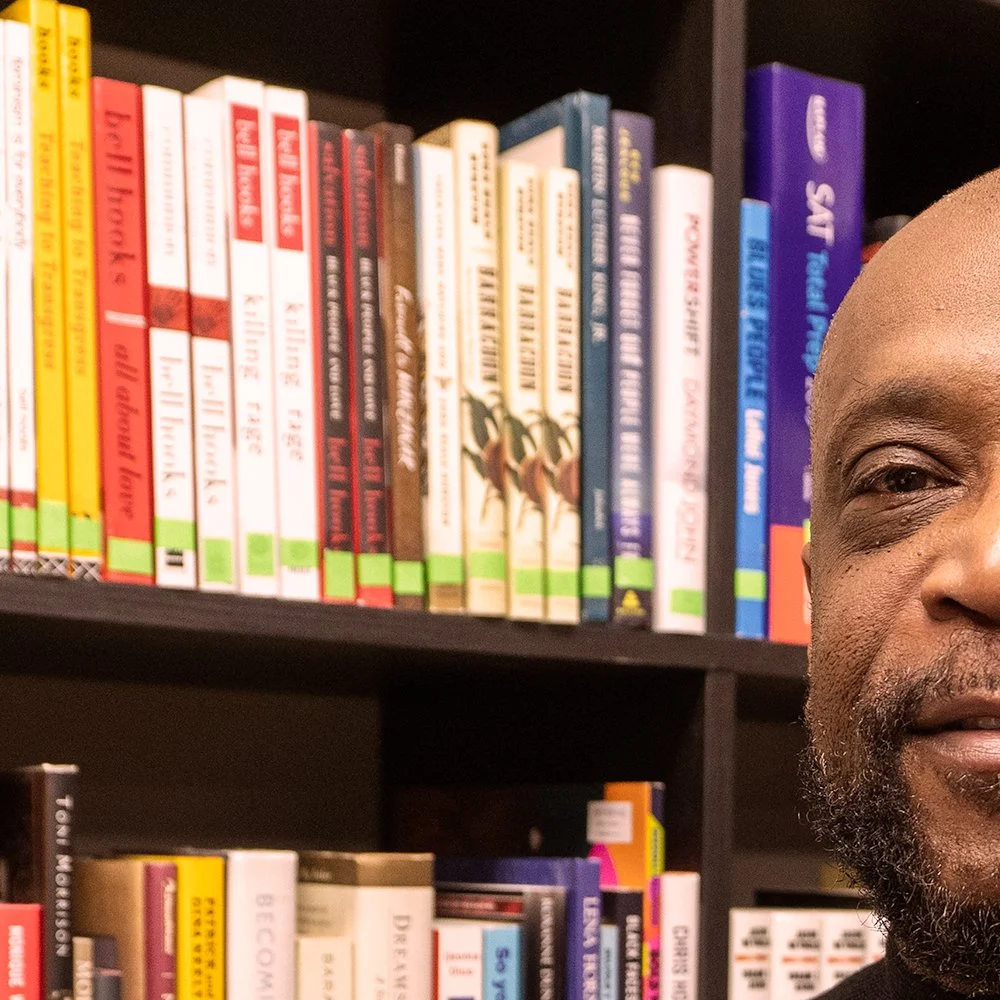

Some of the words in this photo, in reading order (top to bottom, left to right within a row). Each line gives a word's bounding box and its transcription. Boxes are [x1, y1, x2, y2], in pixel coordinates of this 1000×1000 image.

[105, 110, 132, 175] bell
[237, 118, 256, 159] bell
[278, 128, 298, 168] bell
[238, 163, 260, 230] hooks
[280, 173, 300, 239] hooks
[805, 180, 836, 247] SAT
[104, 186, 134, 286] hooks
[683, 213, 701, 358] POWERSHIFT
[112, 343, 134, 377] all
[237, 293, 267, 381] killing
[279, 301, 306, 387] killing
[113, 386, 137, 465] about
[240, 401, 263, 457] rage
[283, 408, 307, 462] rage
[117, 466, 143, 522] love
[55, 795, 75, 848] TONI
[54, 854, 74, 958] MORRISON
[581, 896, 600, 948] LENA
[494, 947, 510, 974] So
[624, 914, 642, 959] BLACK
[671, 925, 689, 976] CHRIS
